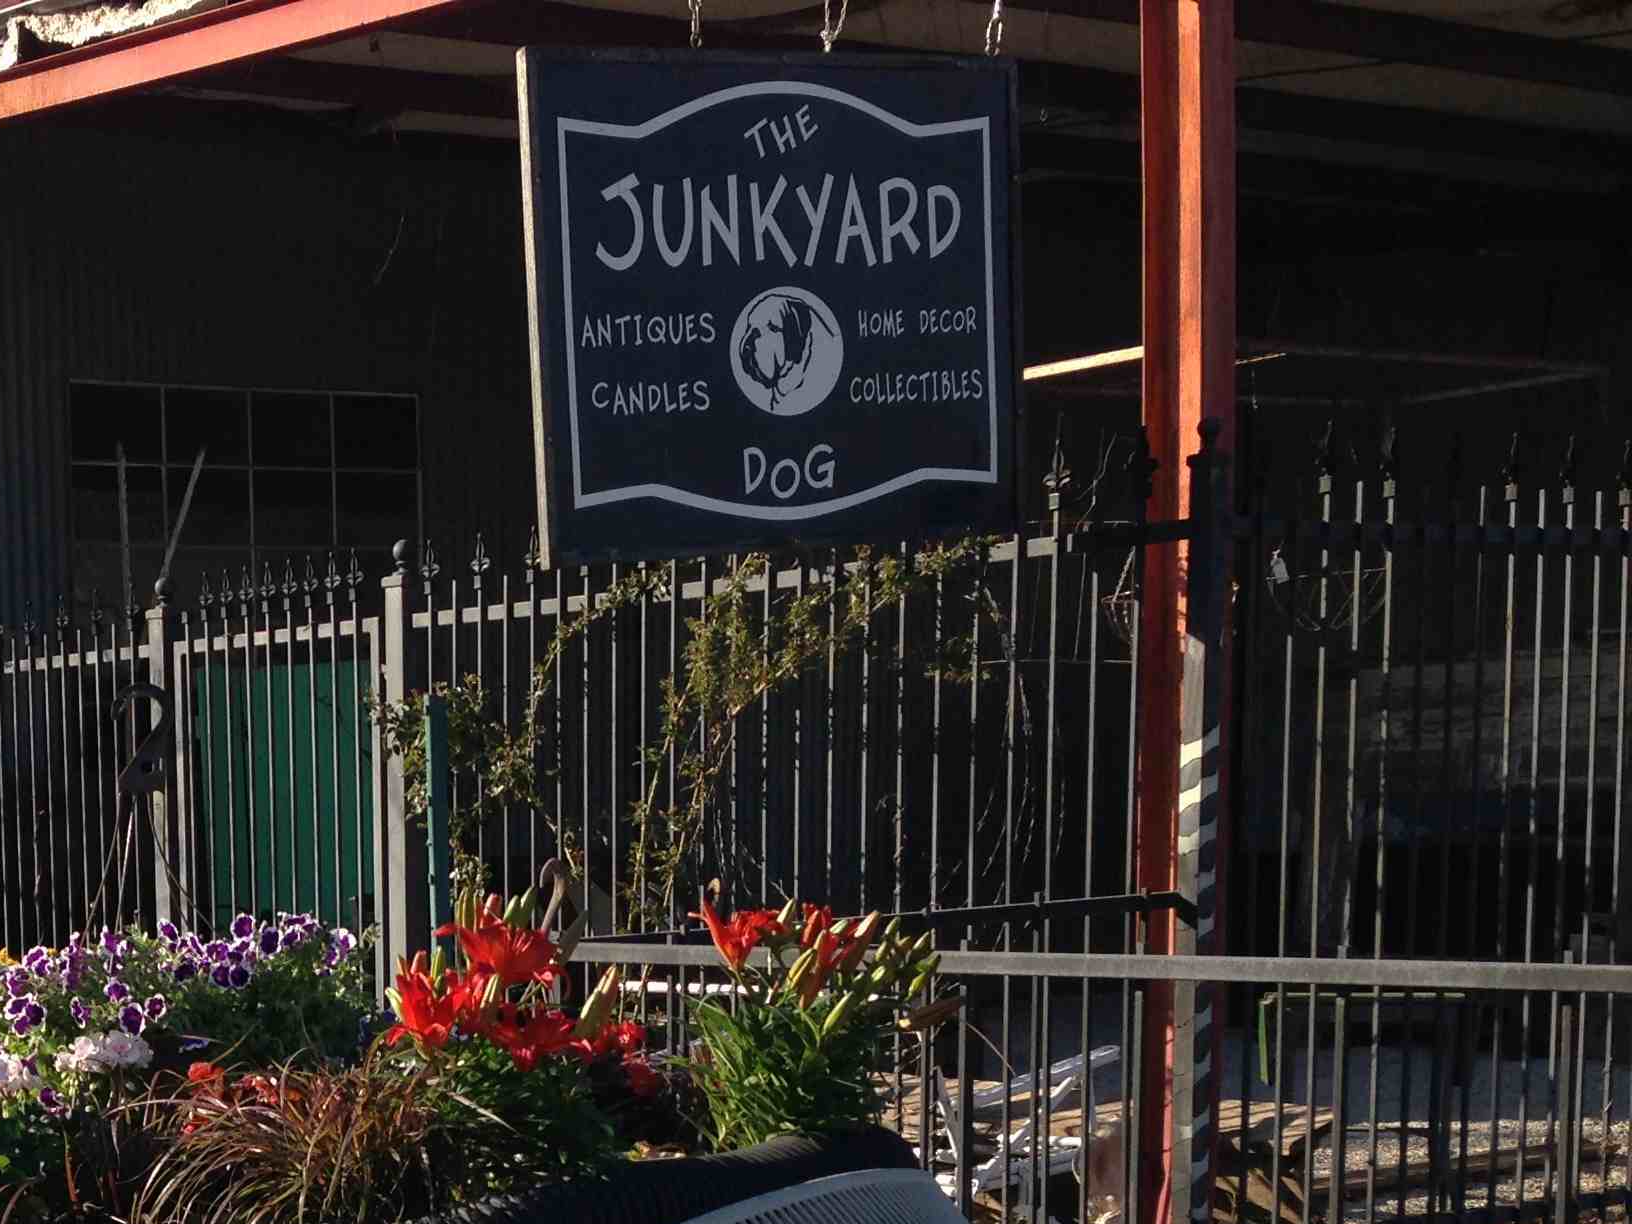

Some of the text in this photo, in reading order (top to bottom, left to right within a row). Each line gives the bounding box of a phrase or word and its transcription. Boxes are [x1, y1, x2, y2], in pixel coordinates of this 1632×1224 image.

[744, 104, 820, 159] THE
[595, 172, 962, 271] JUNKYARD
[581, 312, 717, 349] ANTIQUES
[858, 305, 977, 338] HOME DECOR
[591, 380, 711, 416] CANDLES
[849, 368, 984, 404] COLLECTIBLES
[743, 443, 837, 499] DOG
